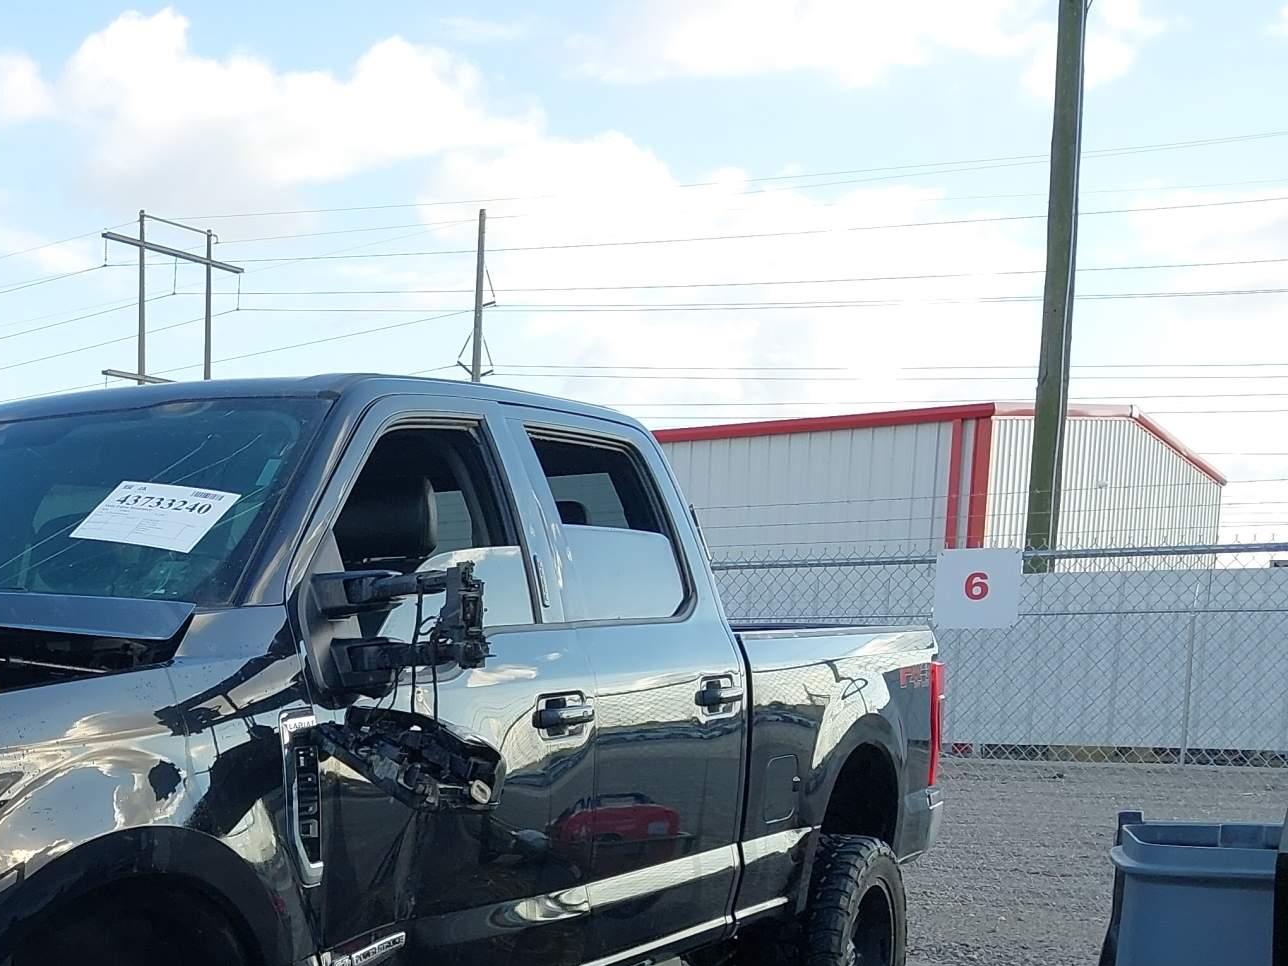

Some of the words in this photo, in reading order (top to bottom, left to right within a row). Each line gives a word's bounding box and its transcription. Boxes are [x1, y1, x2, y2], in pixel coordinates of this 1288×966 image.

[116, 494, 212, 515] 43733240
[964, 571, 990, 601] 6
[288, 721, 314, 730] LARIAT
